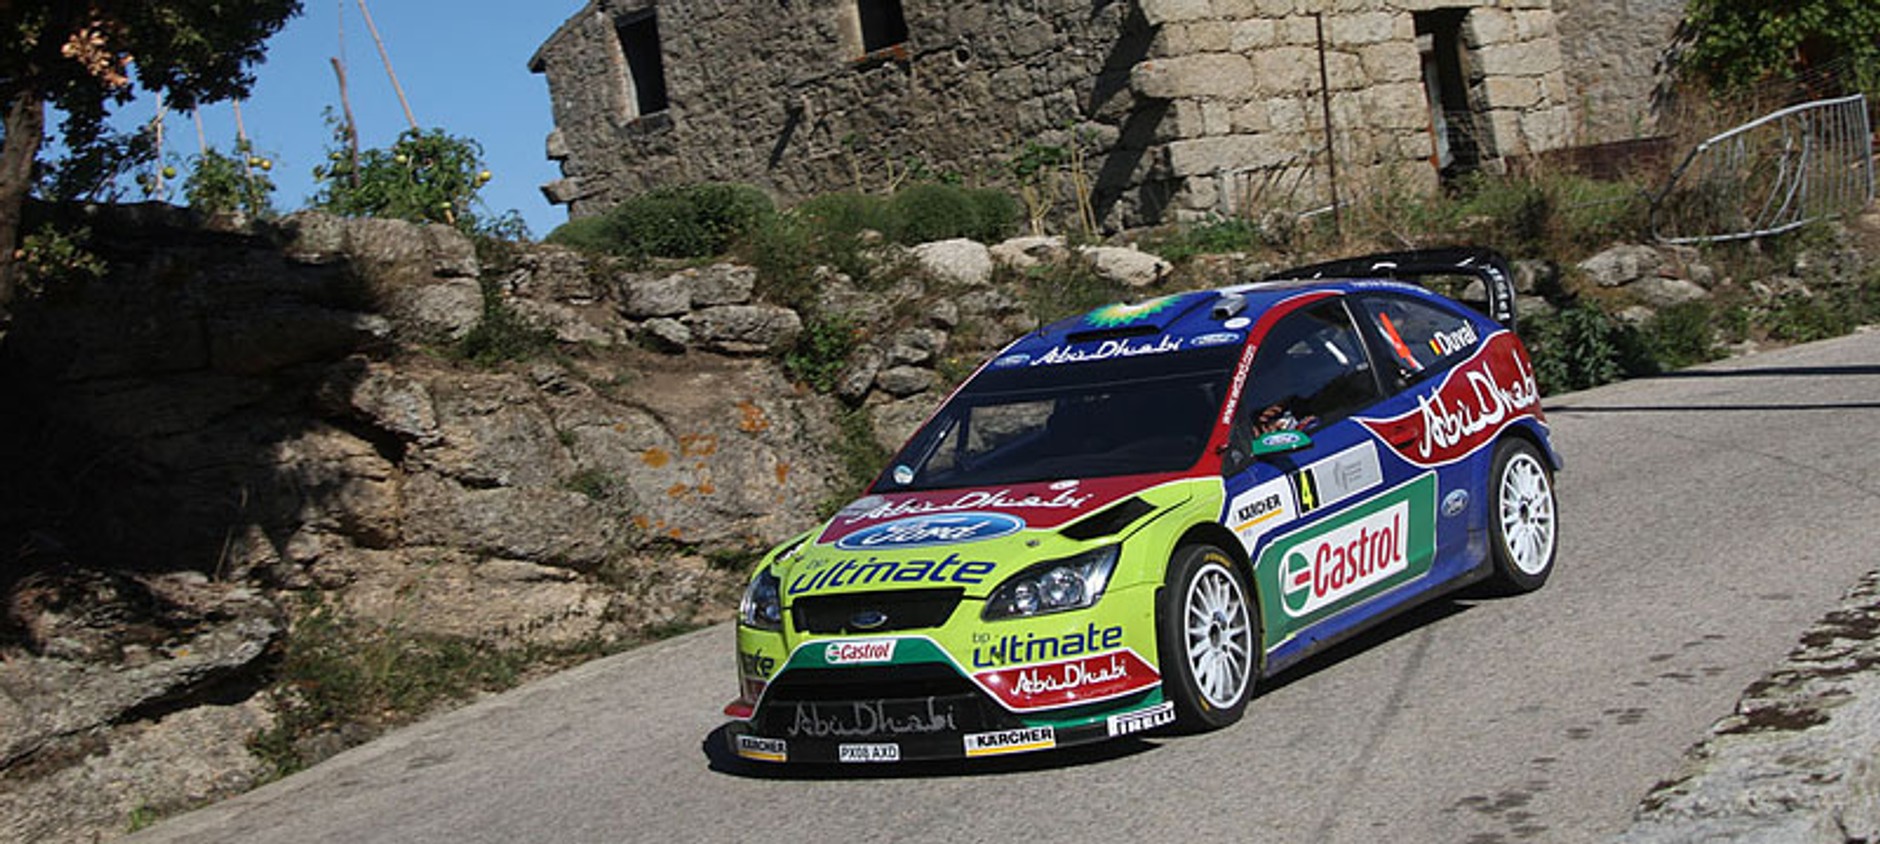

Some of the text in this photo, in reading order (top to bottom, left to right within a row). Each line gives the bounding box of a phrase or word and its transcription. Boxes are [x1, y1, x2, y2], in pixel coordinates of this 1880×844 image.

[1434, 319, 1478, 355] Duval
[1300, 470, 1314, 510] 4
[861, 518, 991, 545] Ford
[788, 553, 997, 595] ultimate
[1313, 513, 1401, 598] Castrol
[840, 642, 891, 661] Castrol
[973, 623, 1122, 668] ultimate
[1108, 700, 1176, 737] PIRELLI
